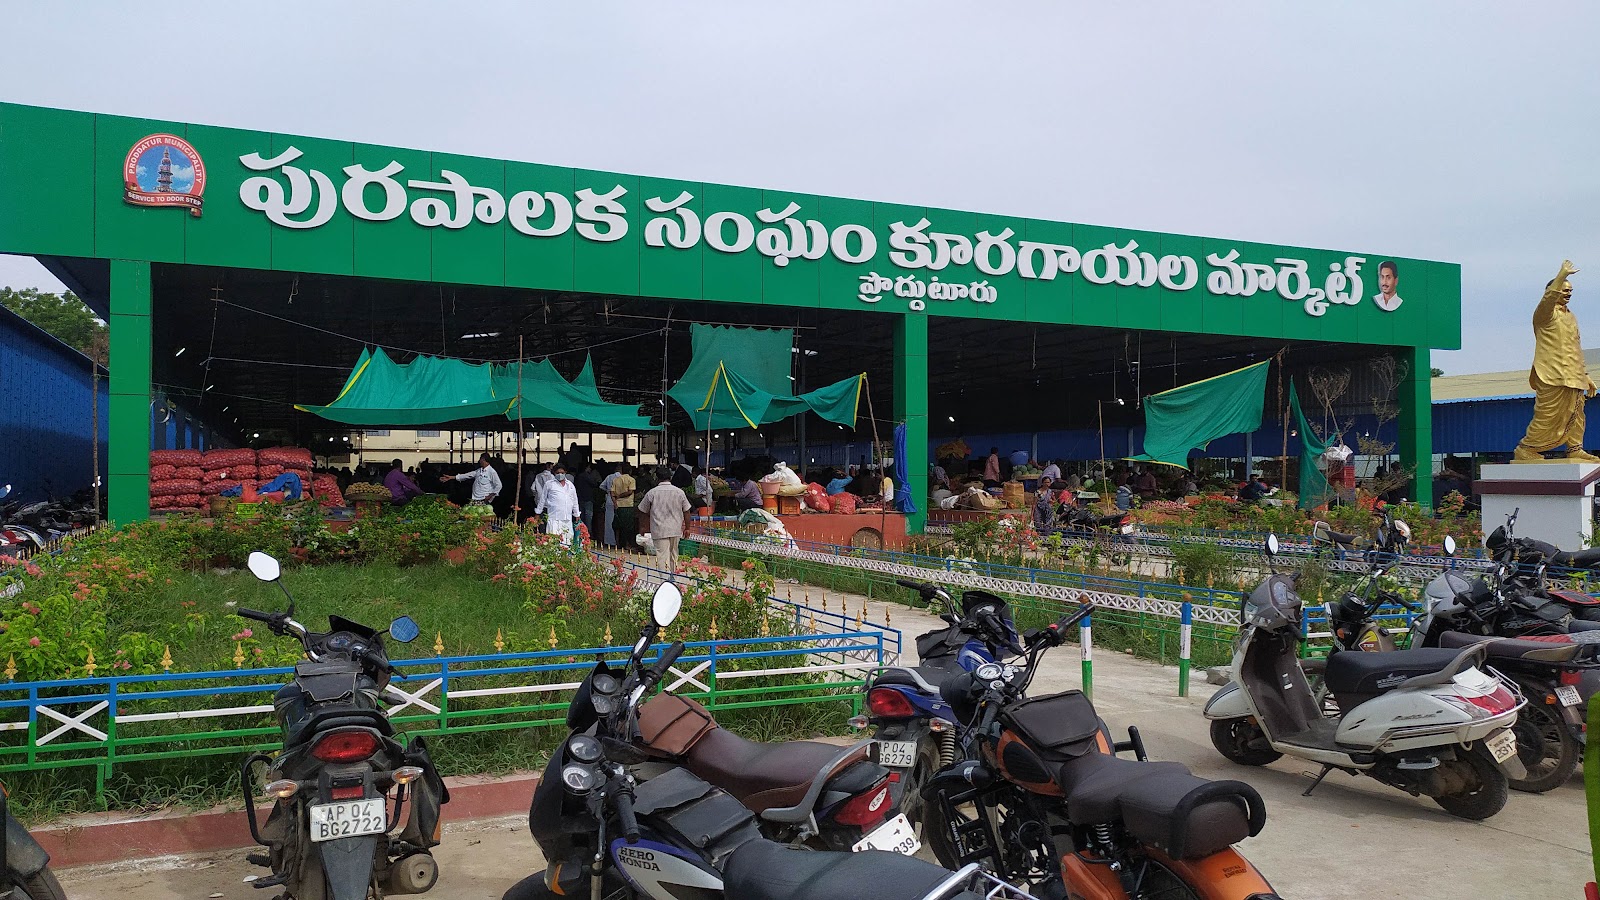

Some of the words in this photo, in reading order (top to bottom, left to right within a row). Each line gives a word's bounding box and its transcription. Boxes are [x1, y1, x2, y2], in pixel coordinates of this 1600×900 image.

[129, 138, 163, 174] PRODDATUR
[164, 138, 203, 183] MUNICIPALITY
[127, 192, 155, 202] SERVICE
[186, 196, 202, 206] STEP
[239, 145, 629, 242] పురపాలక
[644, 190, 877, 267] సంఘం
[888, 217, 1198, 292] కూరగాయల
[1206, 248, 1366, 316] మార్కెట్
[892, 743, 906, 754] 04
[327, 805, 345, 822] AP
[351, 803, 371, 818] 04
[320, 816, 382, 838] BG2722
[620, 846, 655, 861] HERO
[618, 854, 661, 872] HONDA
